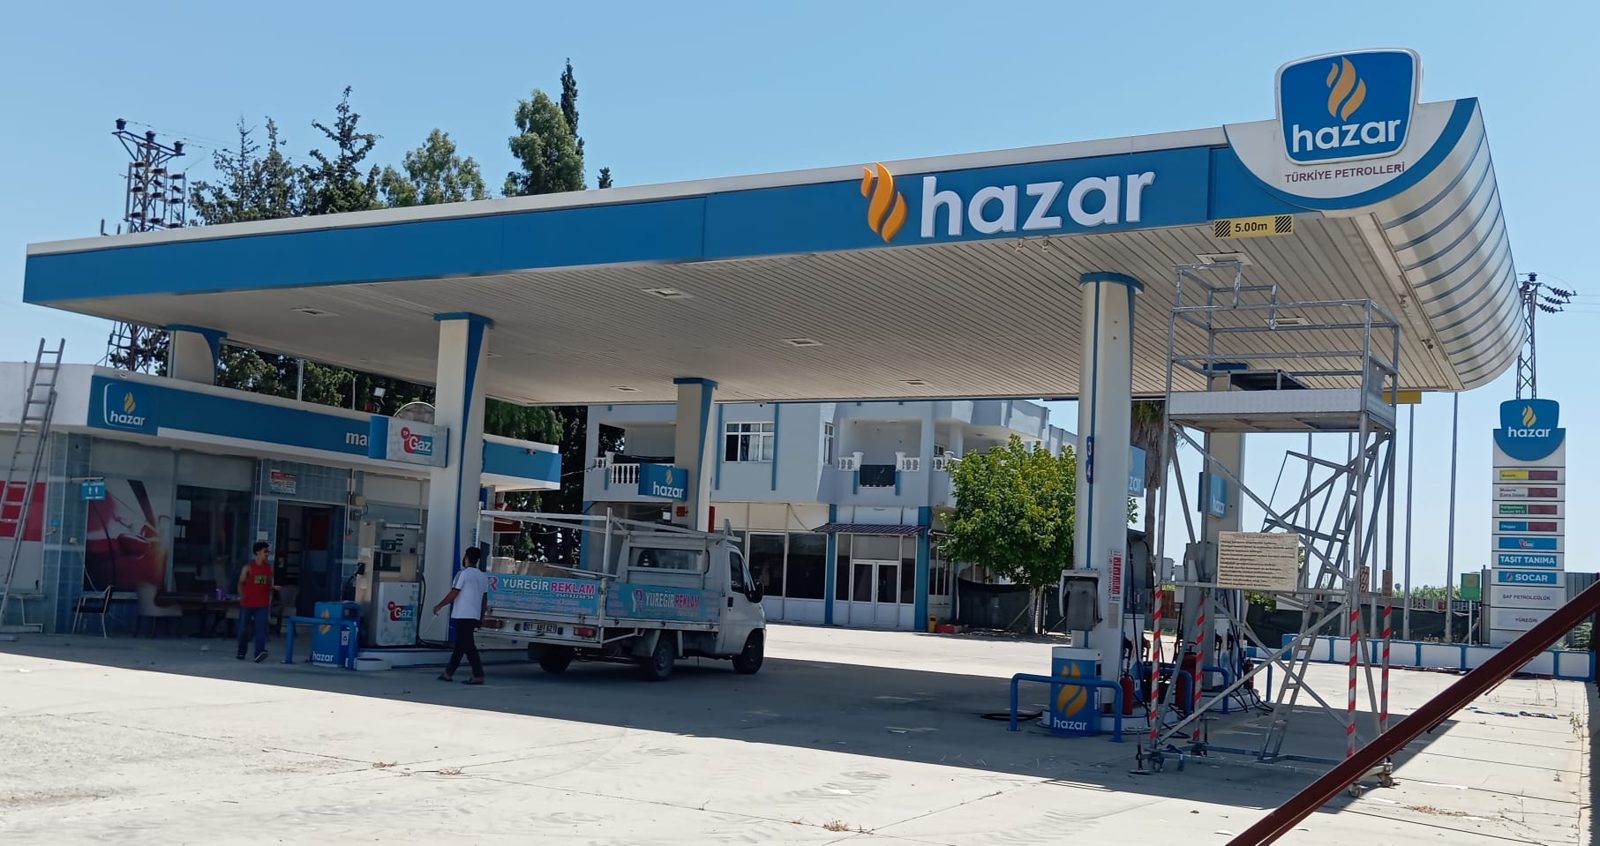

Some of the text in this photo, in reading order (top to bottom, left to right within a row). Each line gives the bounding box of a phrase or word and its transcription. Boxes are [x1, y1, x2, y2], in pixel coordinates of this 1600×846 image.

[1292, 119, 1402, 153] hazar
[1285, 162, 1405, 183] TÜRKİYE PETROLLERİ
[920, 171, 1156, 238] hazar
[1234, 222, 1268, 233] 5.00m
[110, 410, 146, 426] hazar
[345, 431, 369, 447] ma
[1508, 426, 1551, 438] hazar
[408, 436, 432, 452] Gaz
[652, 481, 685, 499] hazar
[1129, 477, 1142, 493] zar
[1500, 555, 1555, 565] TAŞIT TANIMA
[1515, 573, 1549, 583] SOCAR
[550, 582, 595, 594] REKLAM
[394, 607, 412, 618] Gaz
[312, 651, 334, 662] hazar
[1053, 716, 1088, 731] hazar
